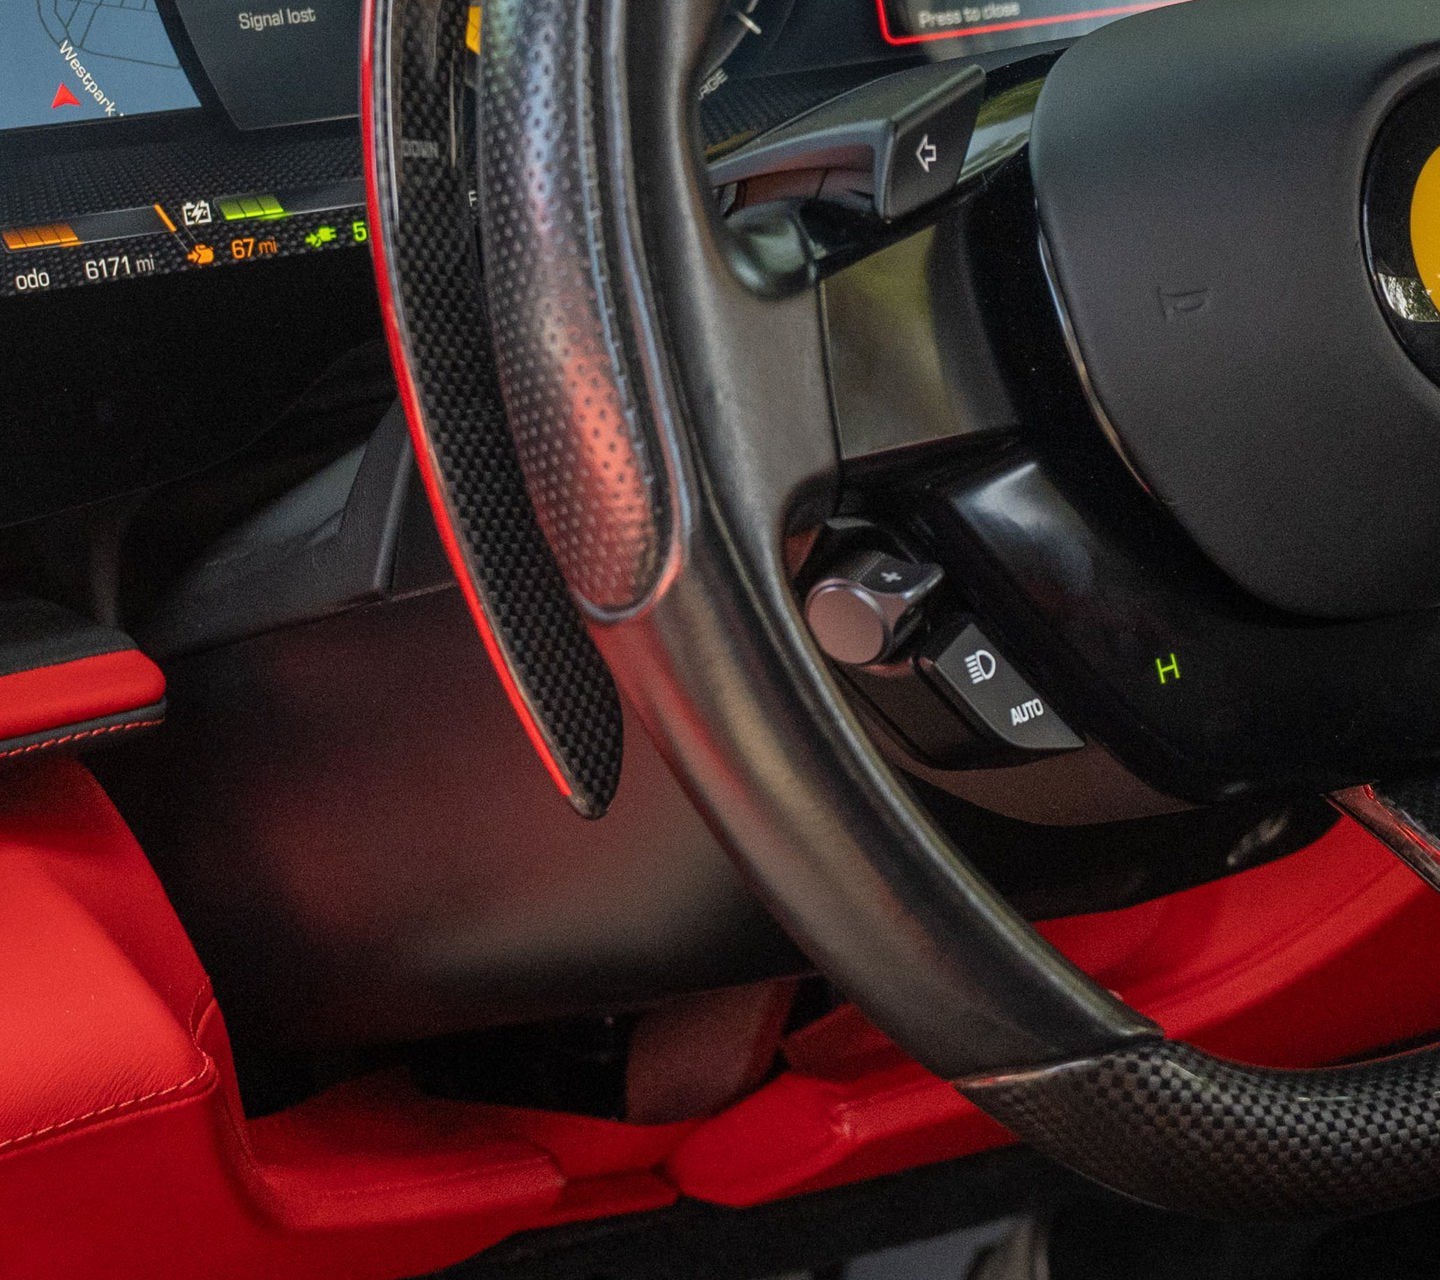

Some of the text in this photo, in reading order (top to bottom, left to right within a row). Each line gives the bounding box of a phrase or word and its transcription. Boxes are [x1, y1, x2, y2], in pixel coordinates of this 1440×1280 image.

[238, 6, 317, 32] Signal lost
[60, 39, 116, 117] Westpark
[231, 237, 278, 260] 67 mi
[15, 253, 155, 290] odo 6171 mi
[1155, 652, 1181, 684] H
[1009, 698, 1045, 727] AUTO
